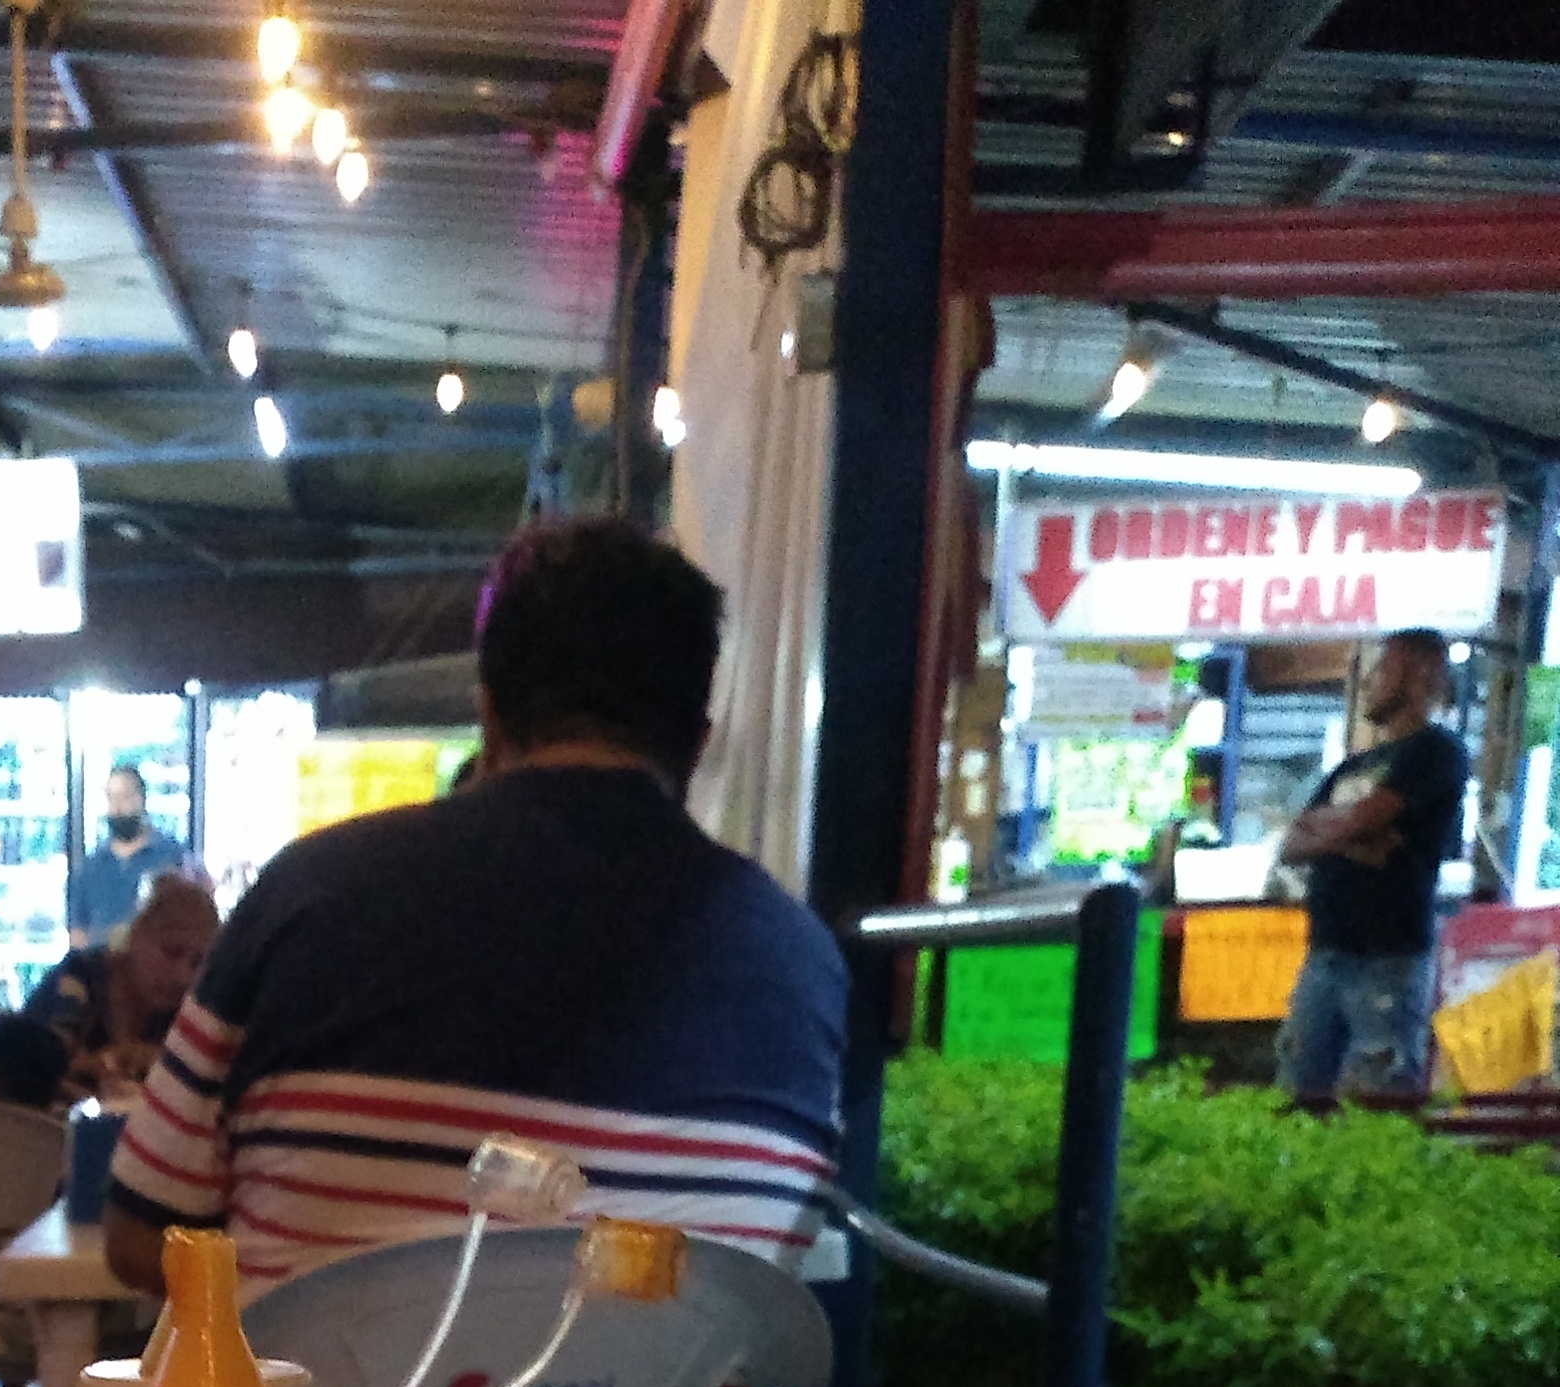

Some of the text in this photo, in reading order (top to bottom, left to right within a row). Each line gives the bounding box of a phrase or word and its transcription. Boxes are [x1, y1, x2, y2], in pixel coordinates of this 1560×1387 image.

[1091, 498, 1504, 561] ORDENE Y PAGUE
[1188, 574, 1378, 631] EN CAJA
